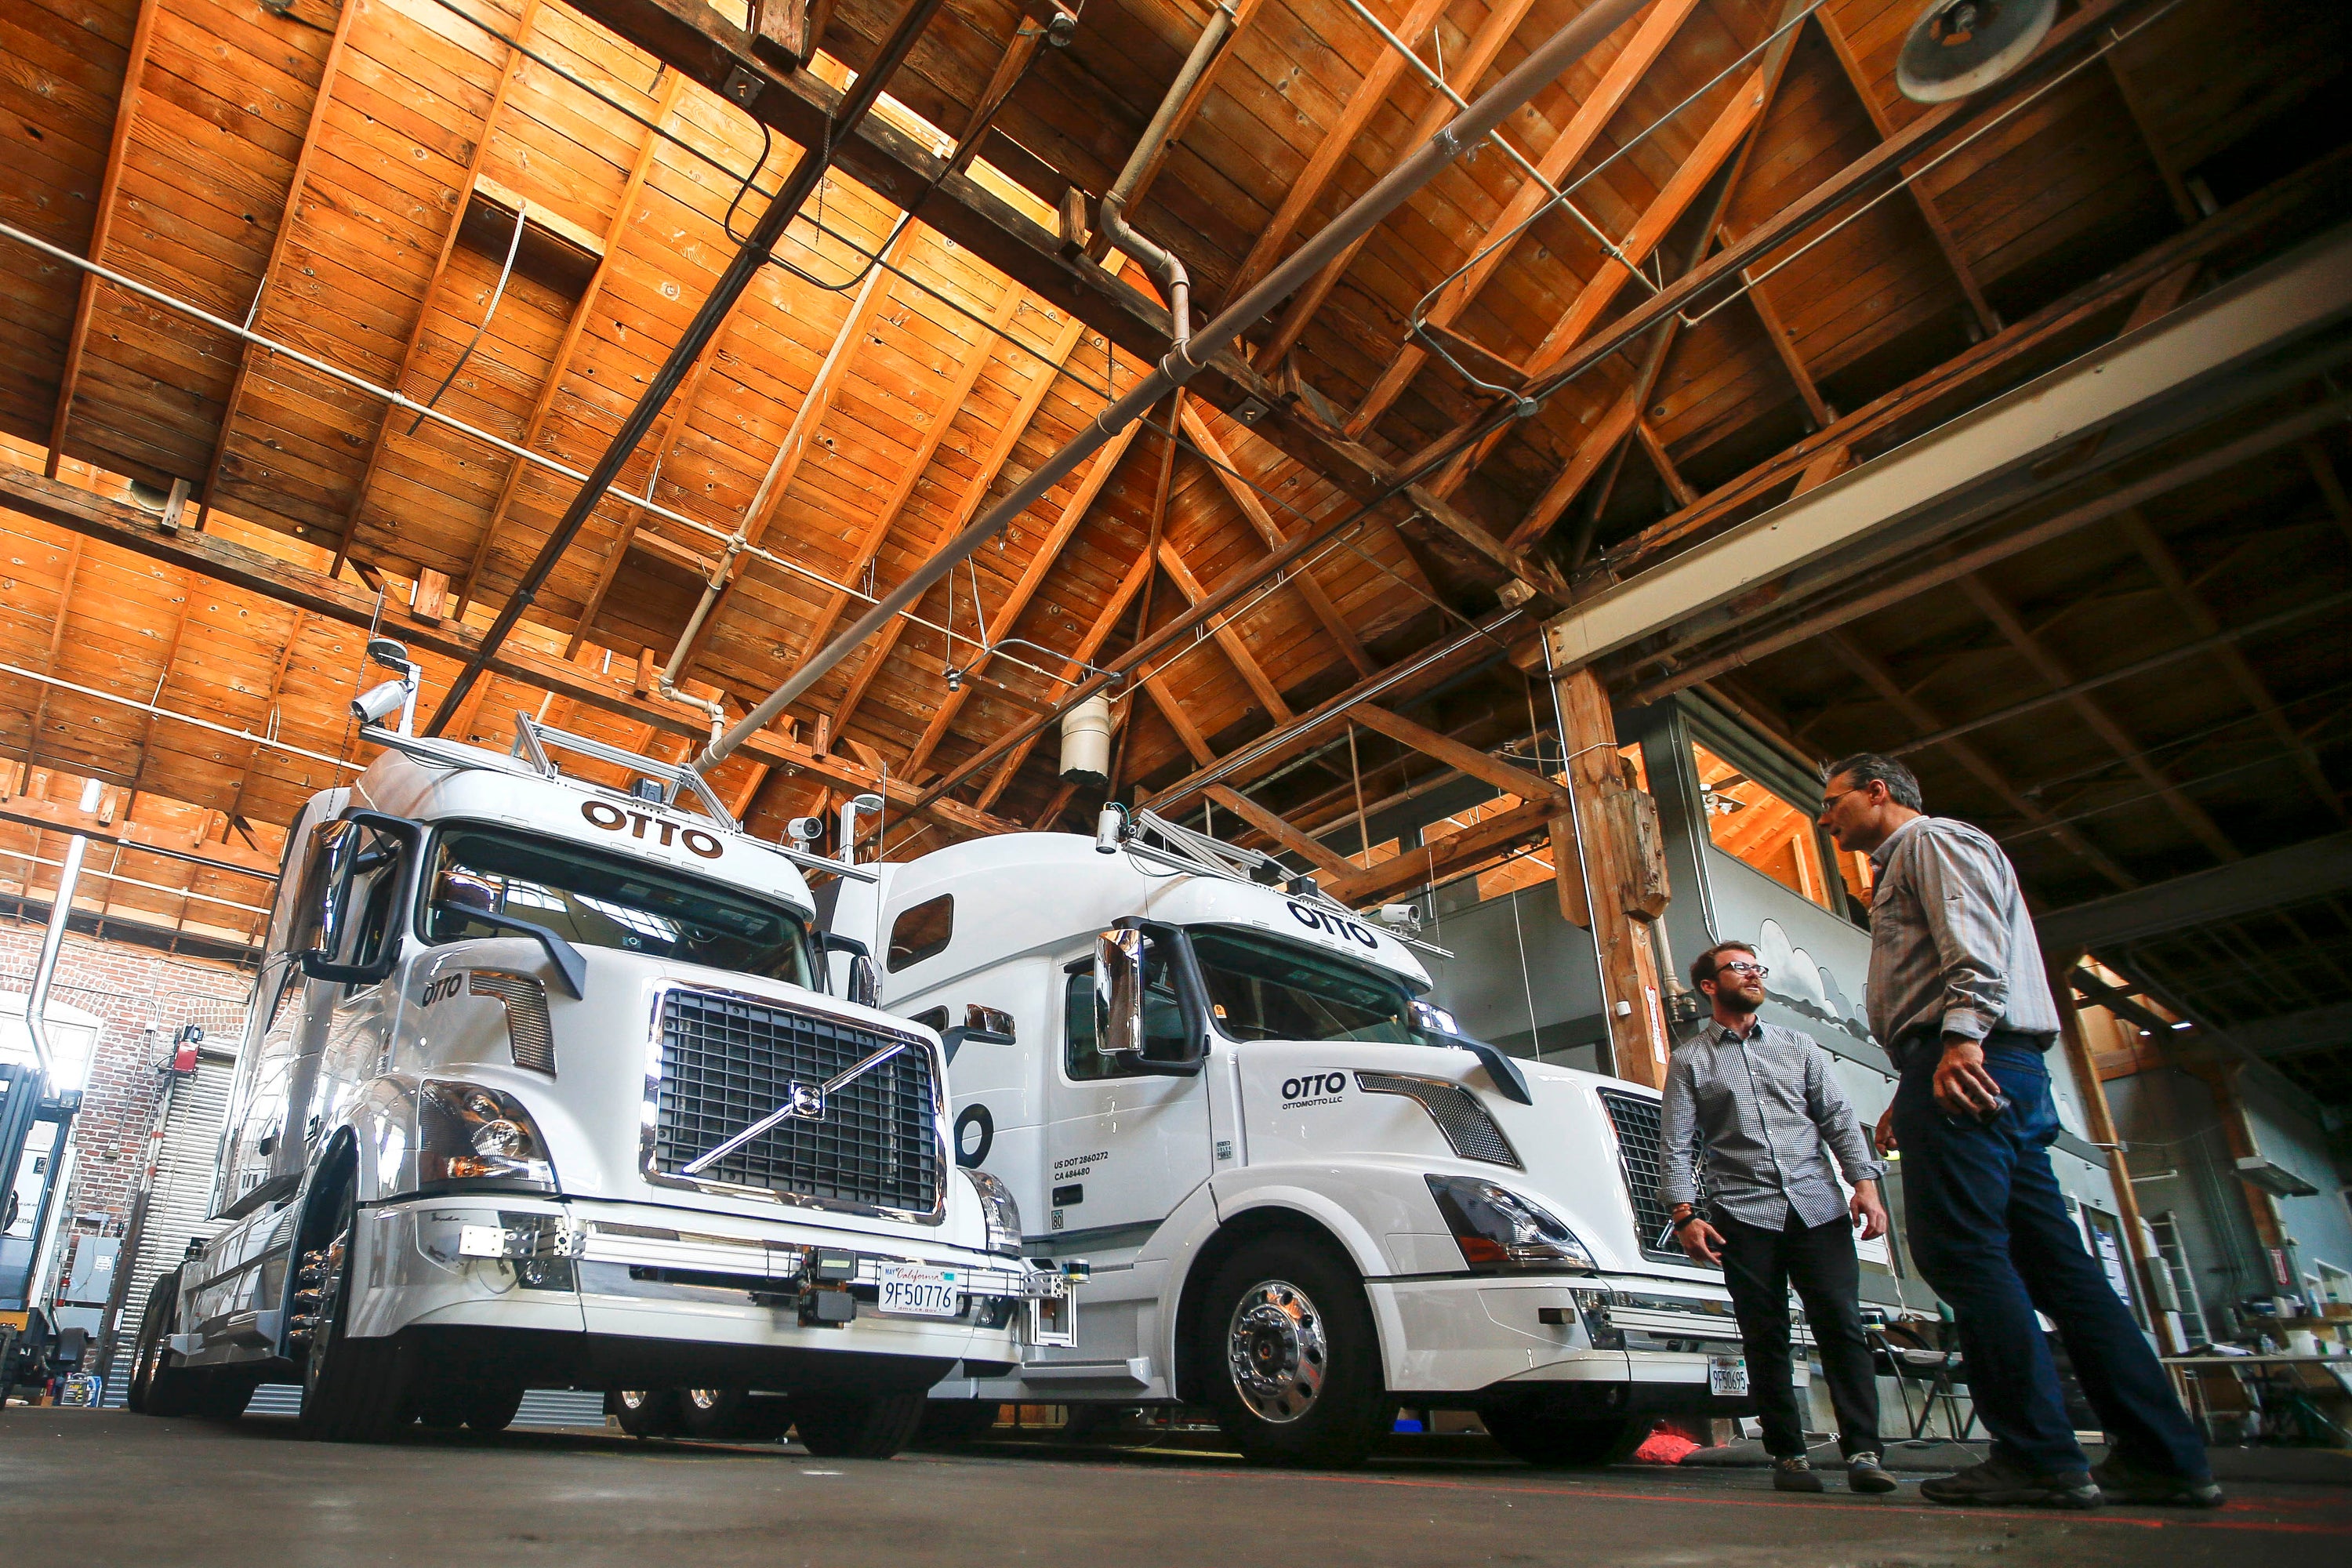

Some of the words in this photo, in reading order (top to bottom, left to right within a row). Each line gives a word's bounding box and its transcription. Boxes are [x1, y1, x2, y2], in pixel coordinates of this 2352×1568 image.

[581, 800, 723, 858] OTTO
[1287, 901, 1378, 949] OTTO
[422, 973, 462, 1007] OTTO
[1282, 1072, 1346, 1100] OTTO
[1283, 1098, 1327, 1109] OTTOMOTTO
[1064, 1158, 1079, 1167] DOT
[1079, 1151, 1109, 1164] 2860272
[1054, 1172, 1064, 1181] CA
[1053, 1214, 1062, 1228] 80
[897, 1268, 942, 1283] California
[884, 1282, 952, 1308] 9F50776
[1713, 1370, 1746, 1390] 9F50695
